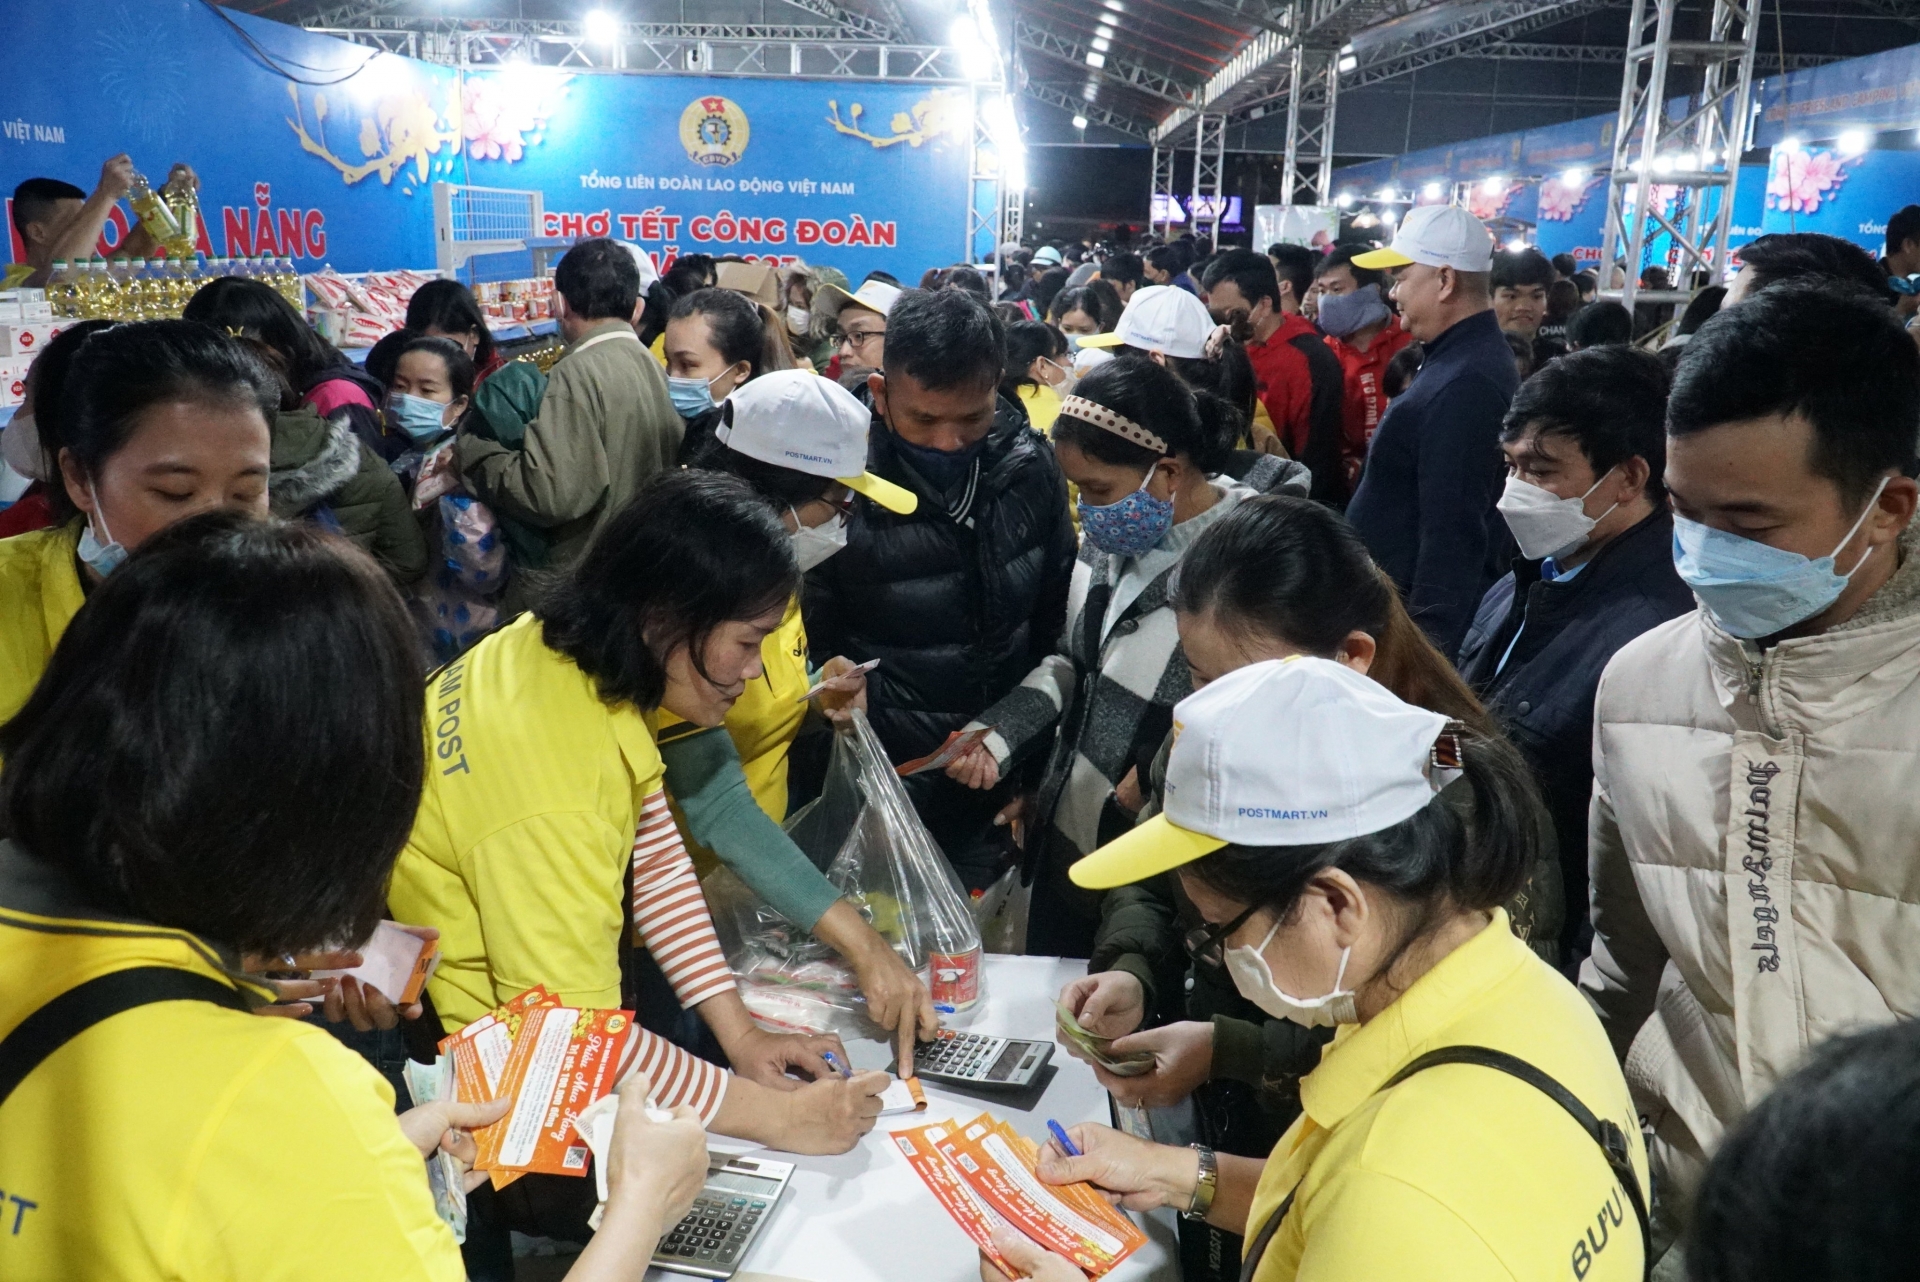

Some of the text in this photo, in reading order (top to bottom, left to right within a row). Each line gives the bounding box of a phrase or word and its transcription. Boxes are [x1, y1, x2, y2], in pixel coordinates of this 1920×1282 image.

[2, 118, 66, 144] VIỆT NAM
[580, 169, 855, 197] TỔNG LIÊN ĐOÀN LAO ĐỘNG VIỆT NAM
[222, 182, 327, 259] NẴNG
[543, 206, 897, 248] CHỢ TẾT CÔNG ĐOÀN
[785, 450, 833, 465] POSTMART.VN
[437, 697, 471, 776] POST
[1238, 807, 1328, 820] POSTMART.VN
[553, 1072, 570, 1105] 100.000
[569, 1072, 588, 1104] Mua
[1571, 1186, 1623, 1282] BƯU
